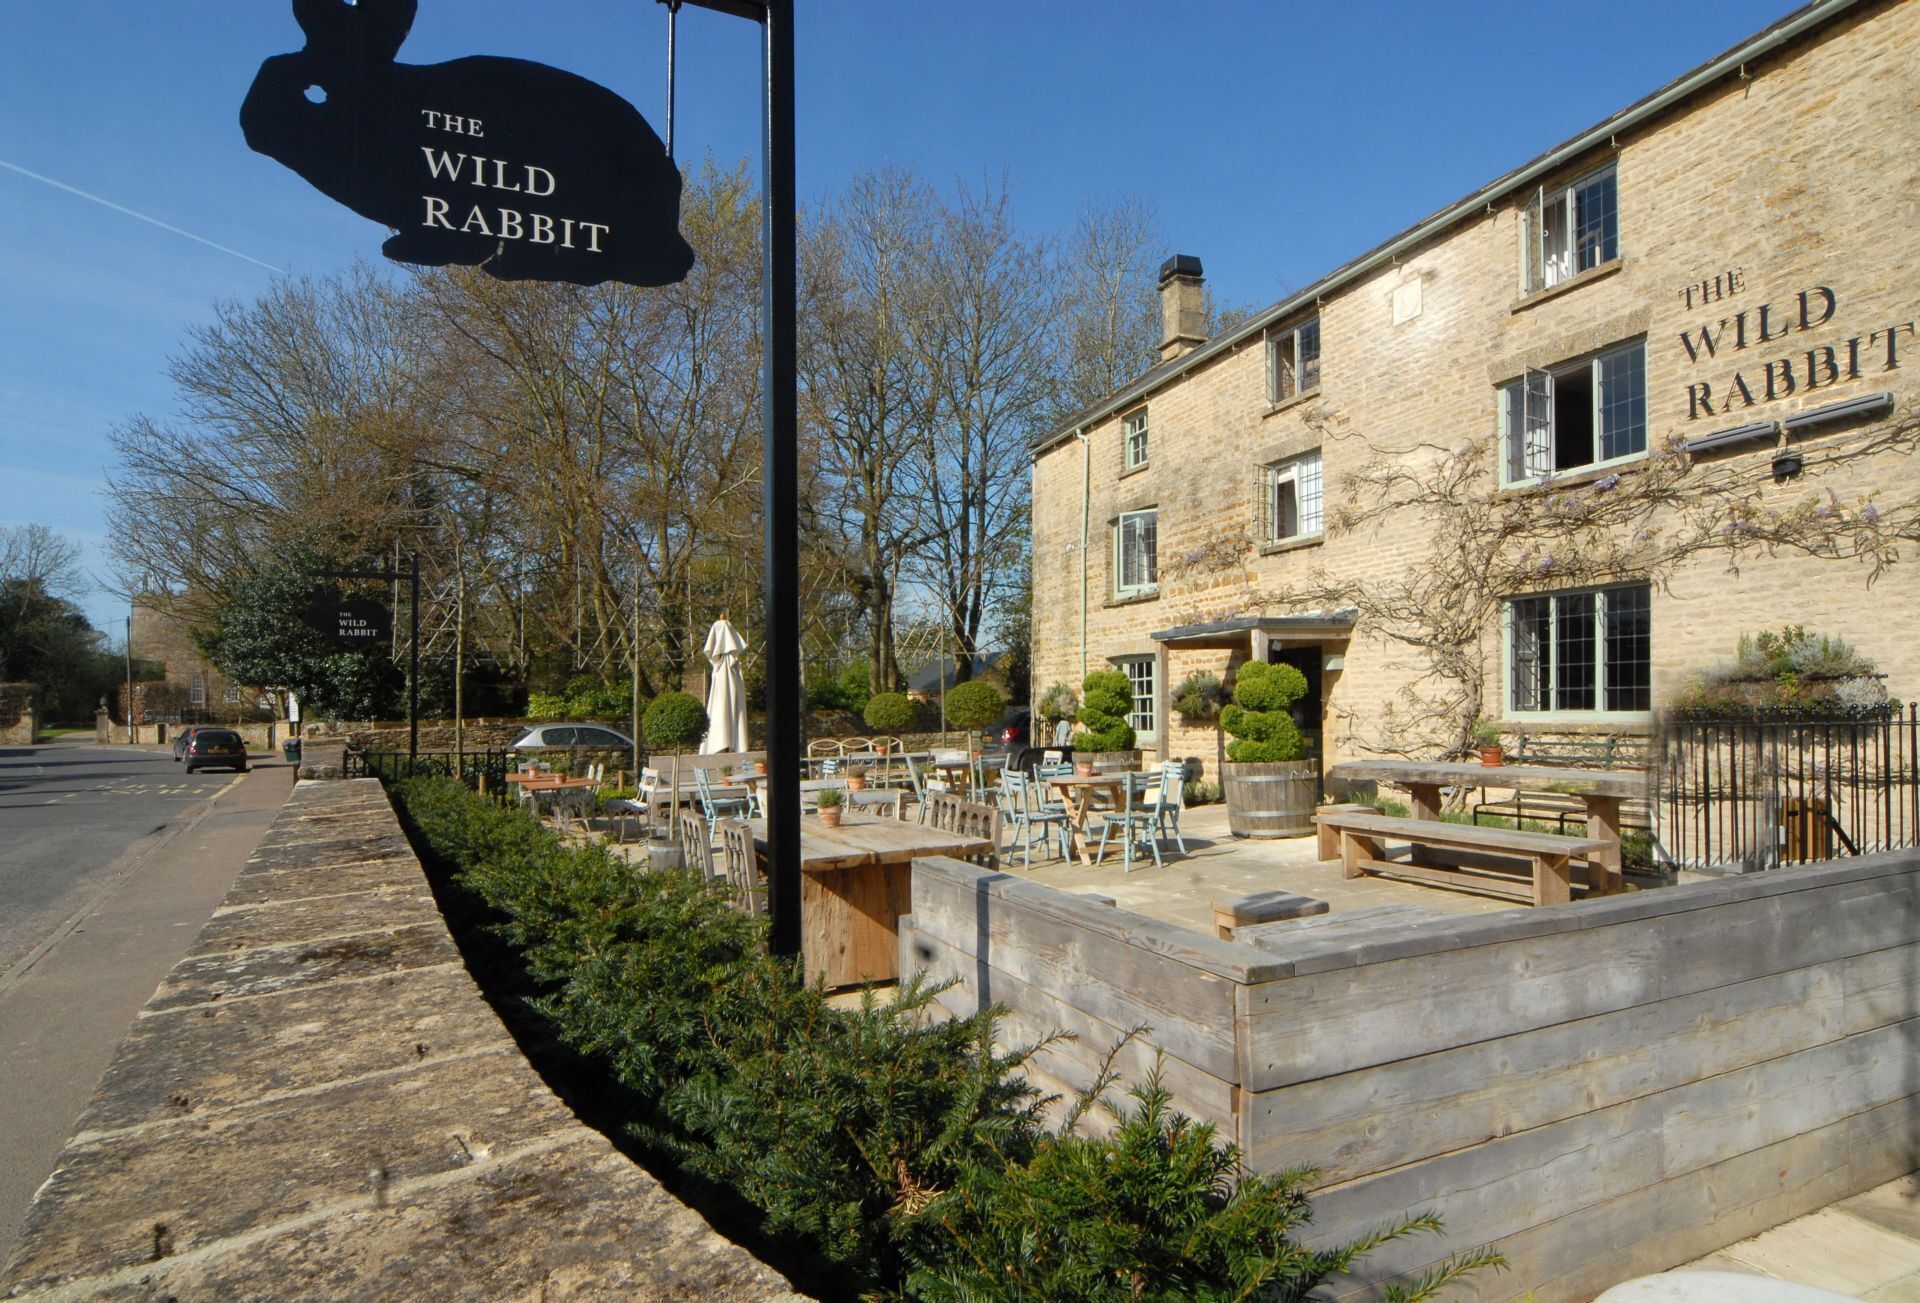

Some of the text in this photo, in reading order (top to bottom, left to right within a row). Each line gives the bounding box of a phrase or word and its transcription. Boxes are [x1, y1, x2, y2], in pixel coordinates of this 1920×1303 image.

[421, 109, 484, 138] THE
[421, 146, 556, 197] WILD
[422, 195, 609, 252] RABBIT
[1678, 267, 1745, 311] THE
[1679, 286, 1836, 364] WILD
[1687, 321, 1915, 420] RABBIT
[339, 619, 367, 627] WILD
[339, 628, 378, 636] RABBIT
